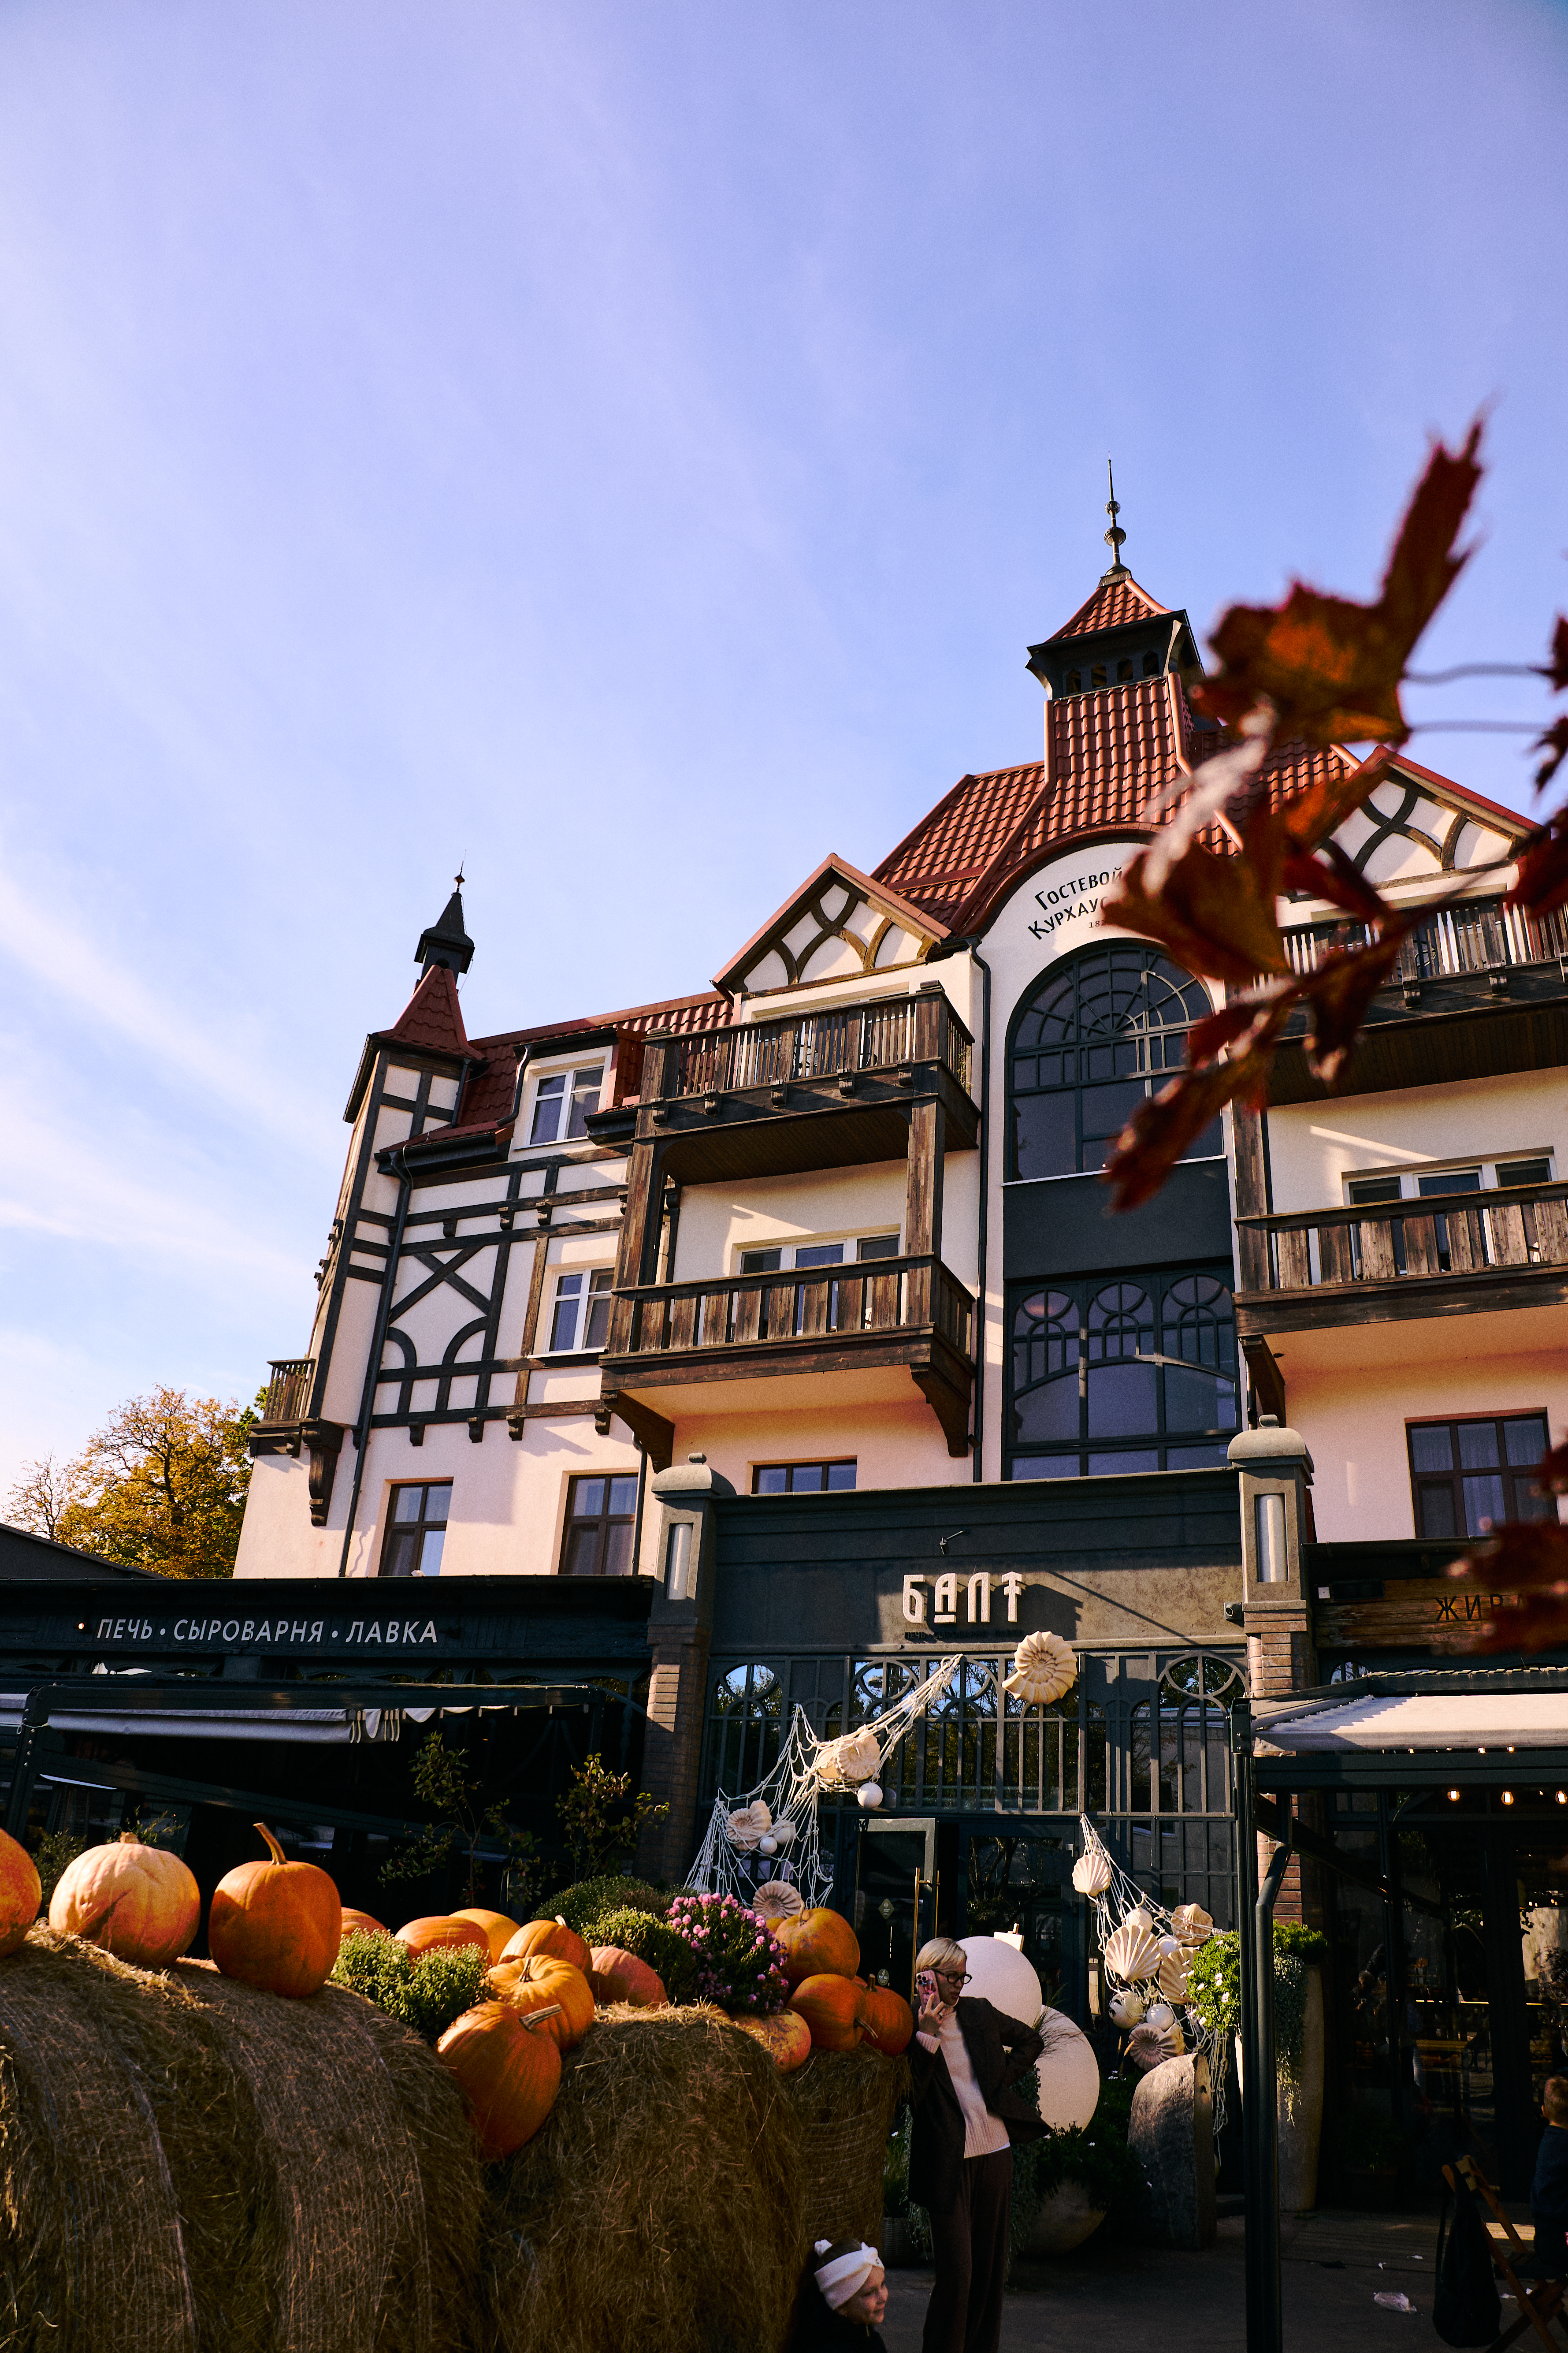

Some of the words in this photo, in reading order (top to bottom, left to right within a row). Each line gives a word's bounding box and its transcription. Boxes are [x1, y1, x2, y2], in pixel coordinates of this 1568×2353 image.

[902, 1571, 1022, 1623] БАЛТ
[97, 1619, 152, 1640] ПЕЧЬ
[173, 1619, 324, 1642] СЫРОВАРНЯ
[345, 1620, 438, 1643] ЛАВКА
